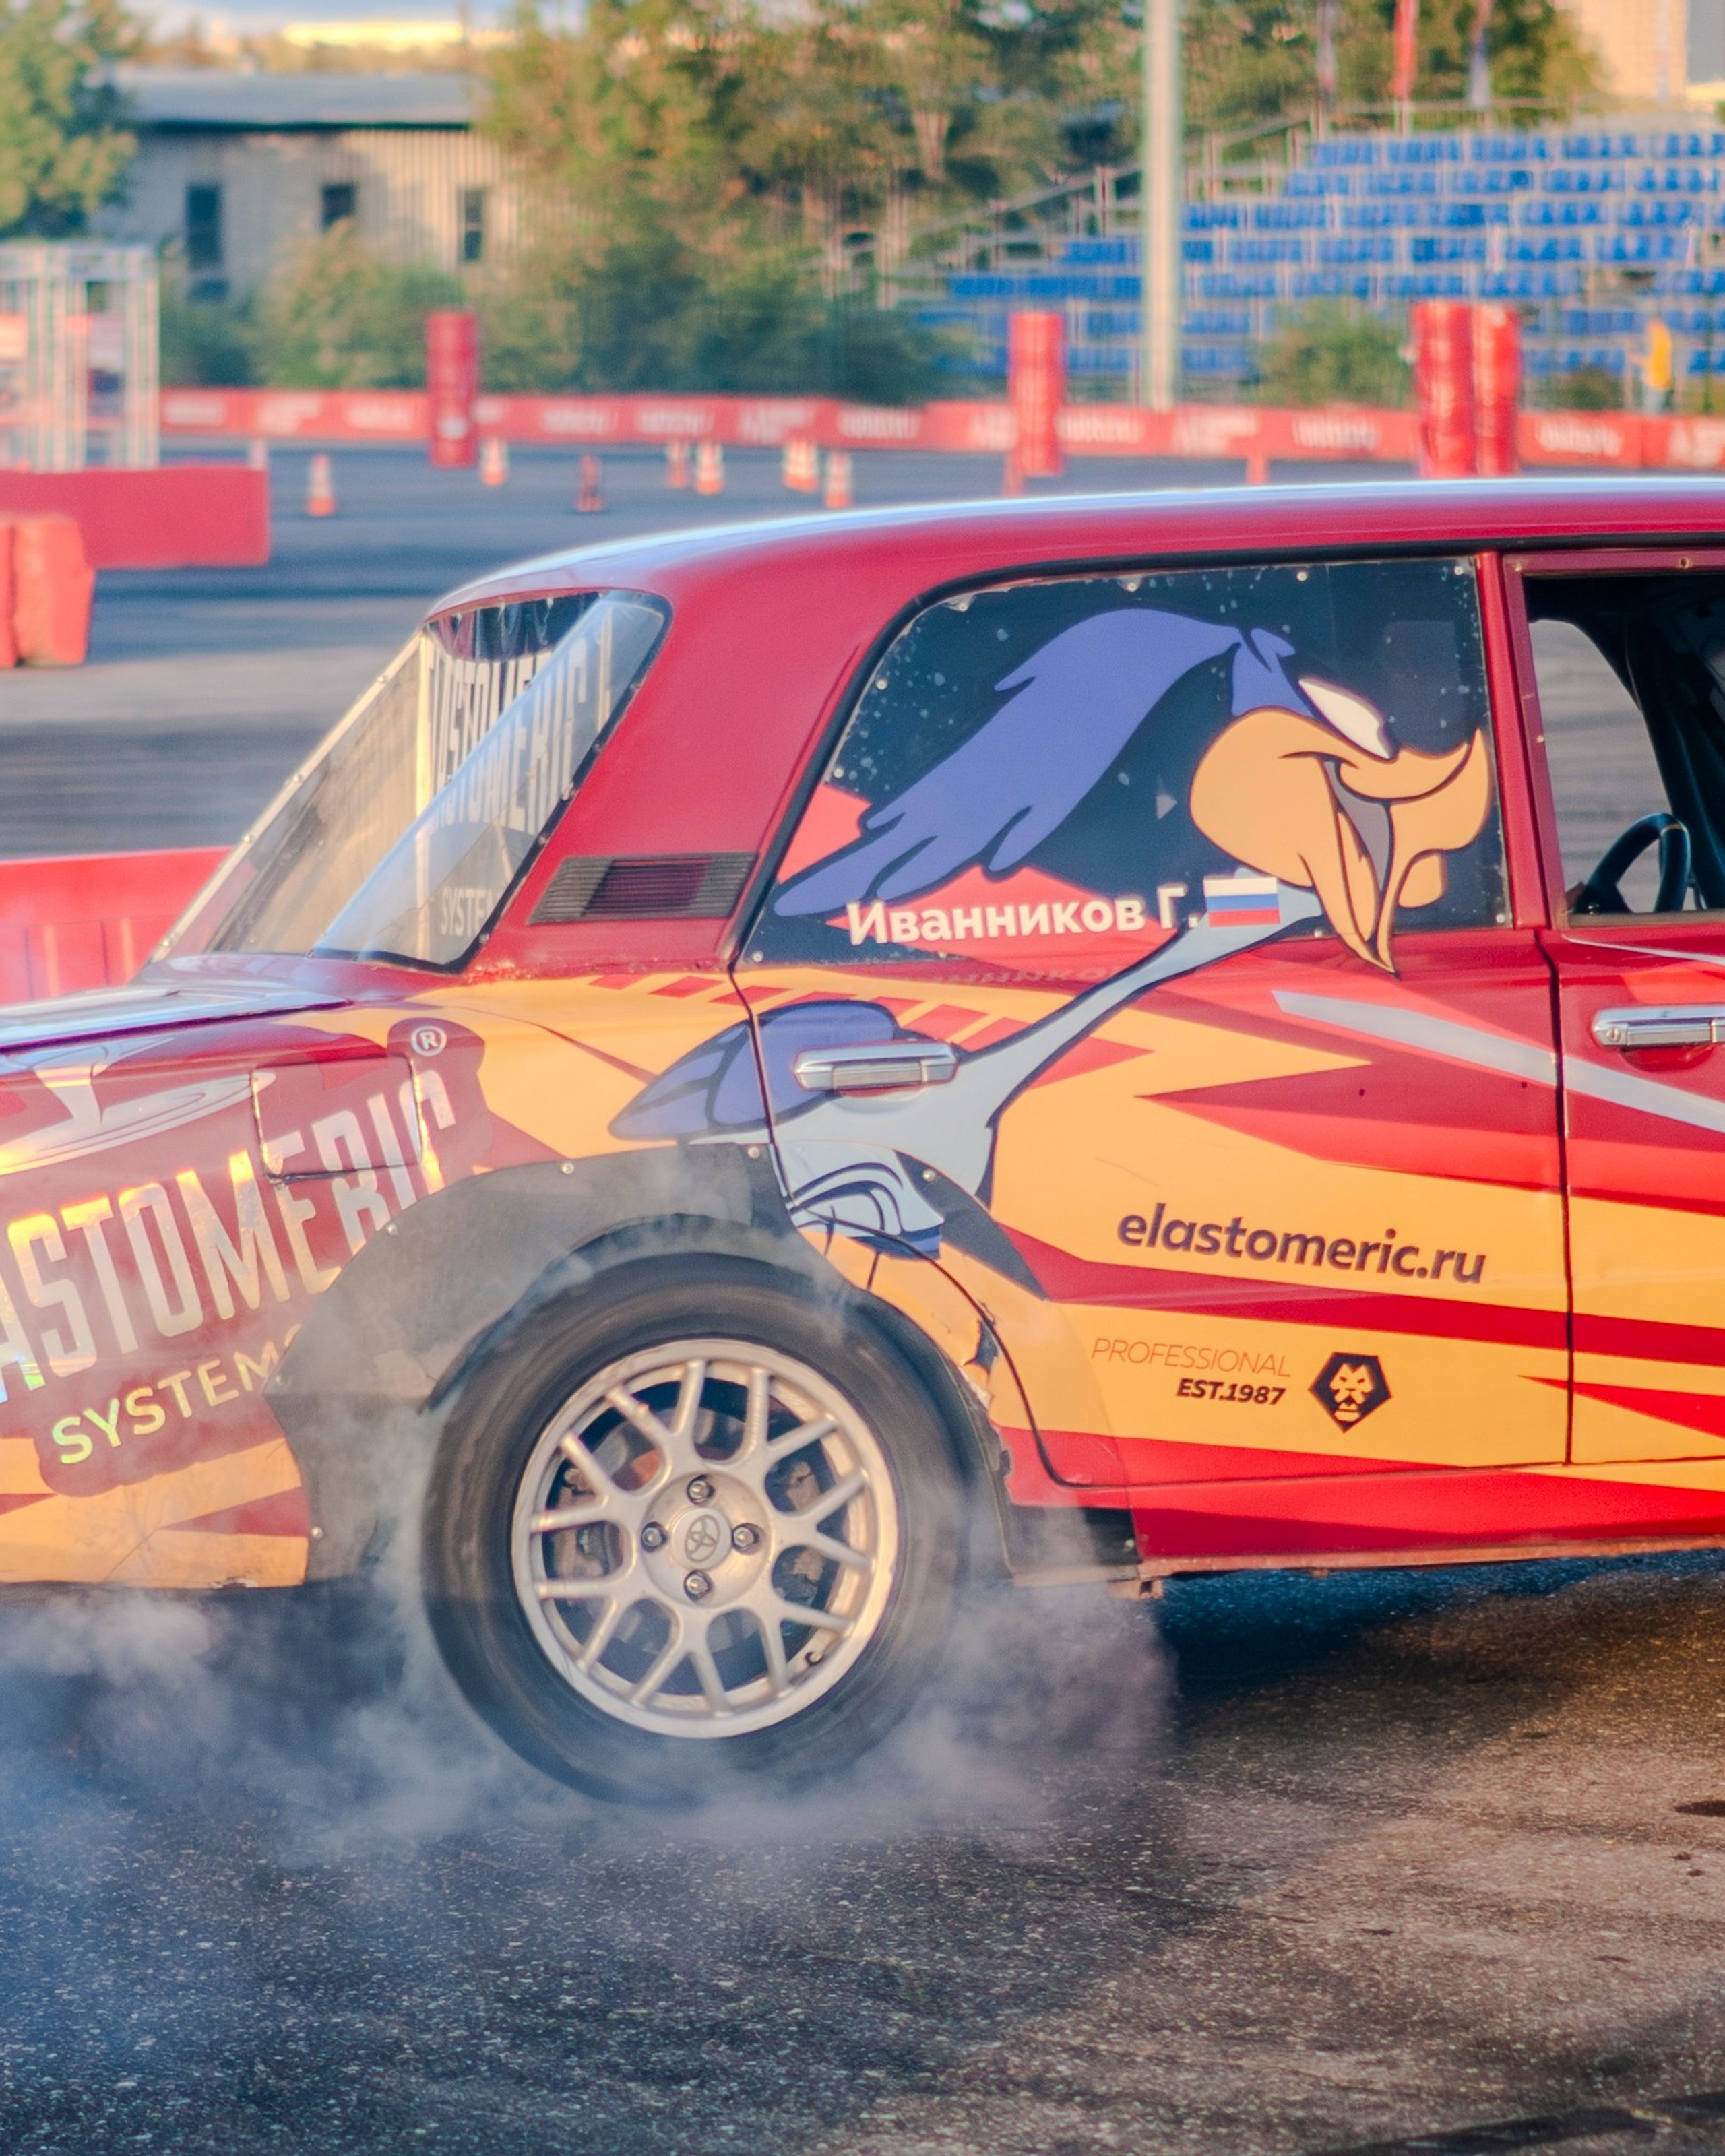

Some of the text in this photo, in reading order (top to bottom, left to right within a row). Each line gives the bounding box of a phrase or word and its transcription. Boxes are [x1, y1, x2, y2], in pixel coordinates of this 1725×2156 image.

[845, 883, 1199, 947] Иванников Г.
[1117, 1203, 1487, 1284] elastomeric.ru
[1092, 1337, 1292, 1378] PROFESSIONAL
[52, 1324, 302, 1465] SYSTEM
[1176, 1378, 1286, 1406] EST.1987
